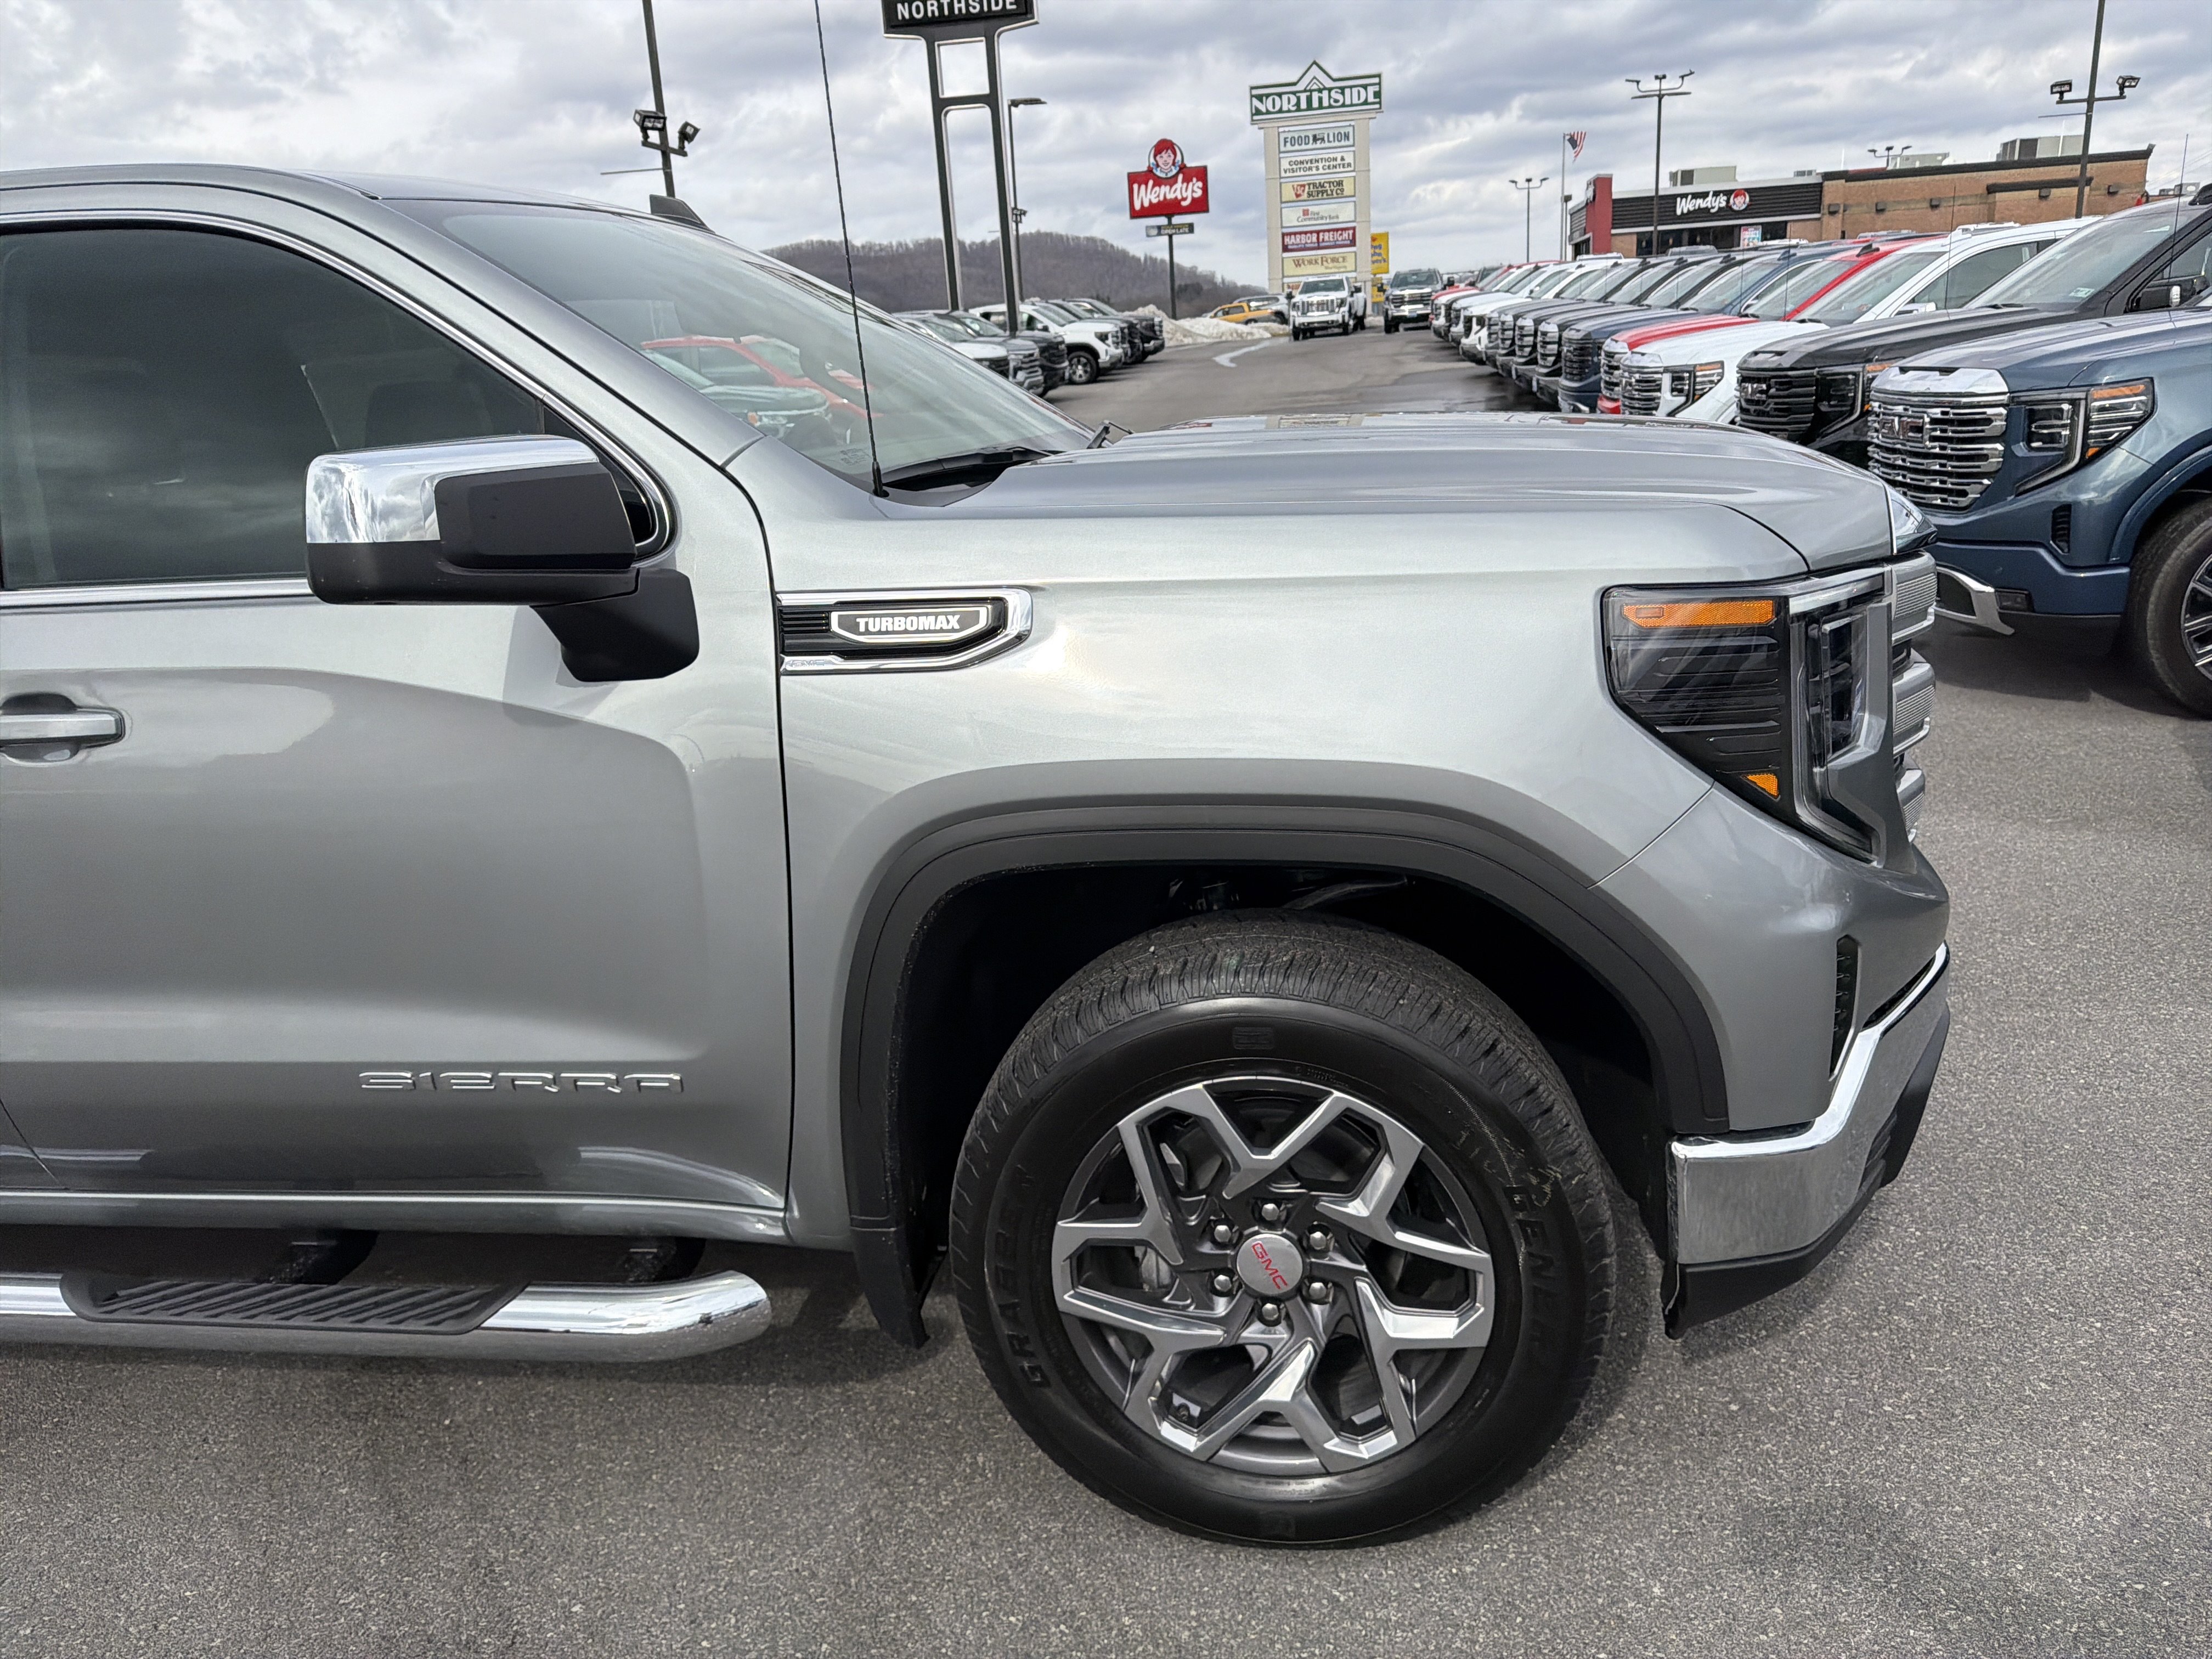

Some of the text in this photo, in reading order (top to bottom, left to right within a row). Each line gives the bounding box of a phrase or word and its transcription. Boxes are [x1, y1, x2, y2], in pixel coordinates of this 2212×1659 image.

[897, 0, 1017, 20] NORTHSIDE
[1251, 85, 1380, 114] NORTHSIDE
[1283, 131, 1350, 148] FOOD LION
[1283, 162, 1352, 174] VISITOR'S CENTER
[1288, 156, 1338, 166] CONVENTION
[1132, 173, 1203, 211] Wendy's
[1306, 179, 1344, 190] TRACTOR
[1306, 188, 1335, 198] SUPPLY
[1676, 190, 1728, 216] Wendy's
[1284, 233, 1318, 245] HARBOR
[1319, 230, 1354, 242] FREIGHT
[856, 614, 961, 632] TURBOMAX
[358, 1070, 684, 1094] SIERRA
[1251, 1242, 1288, 1290] GMC
